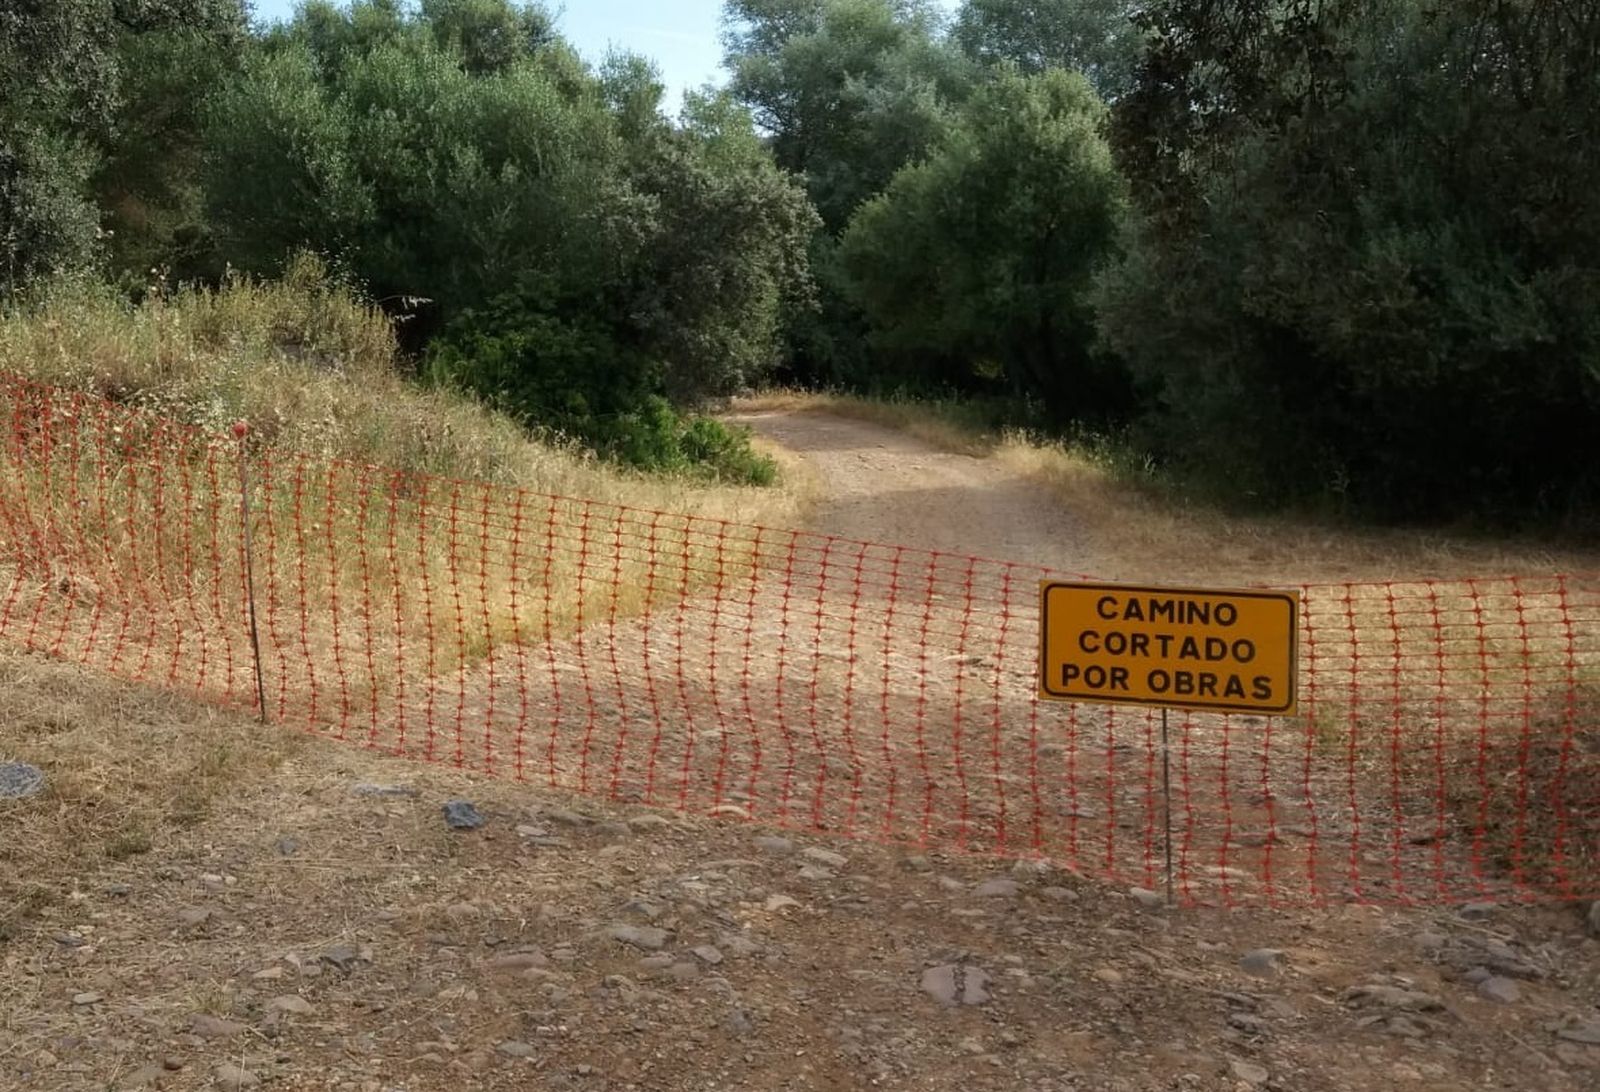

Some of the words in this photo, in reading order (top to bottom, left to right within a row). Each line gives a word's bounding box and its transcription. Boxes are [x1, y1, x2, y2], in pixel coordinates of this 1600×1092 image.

[1097, 596, 1238, 626] CAMINO
[1078, 630, 1256, 663] CORTADO
[1061, 663, 1130, 691] POR
[1147, 669, 1273, 700] OBRAS
